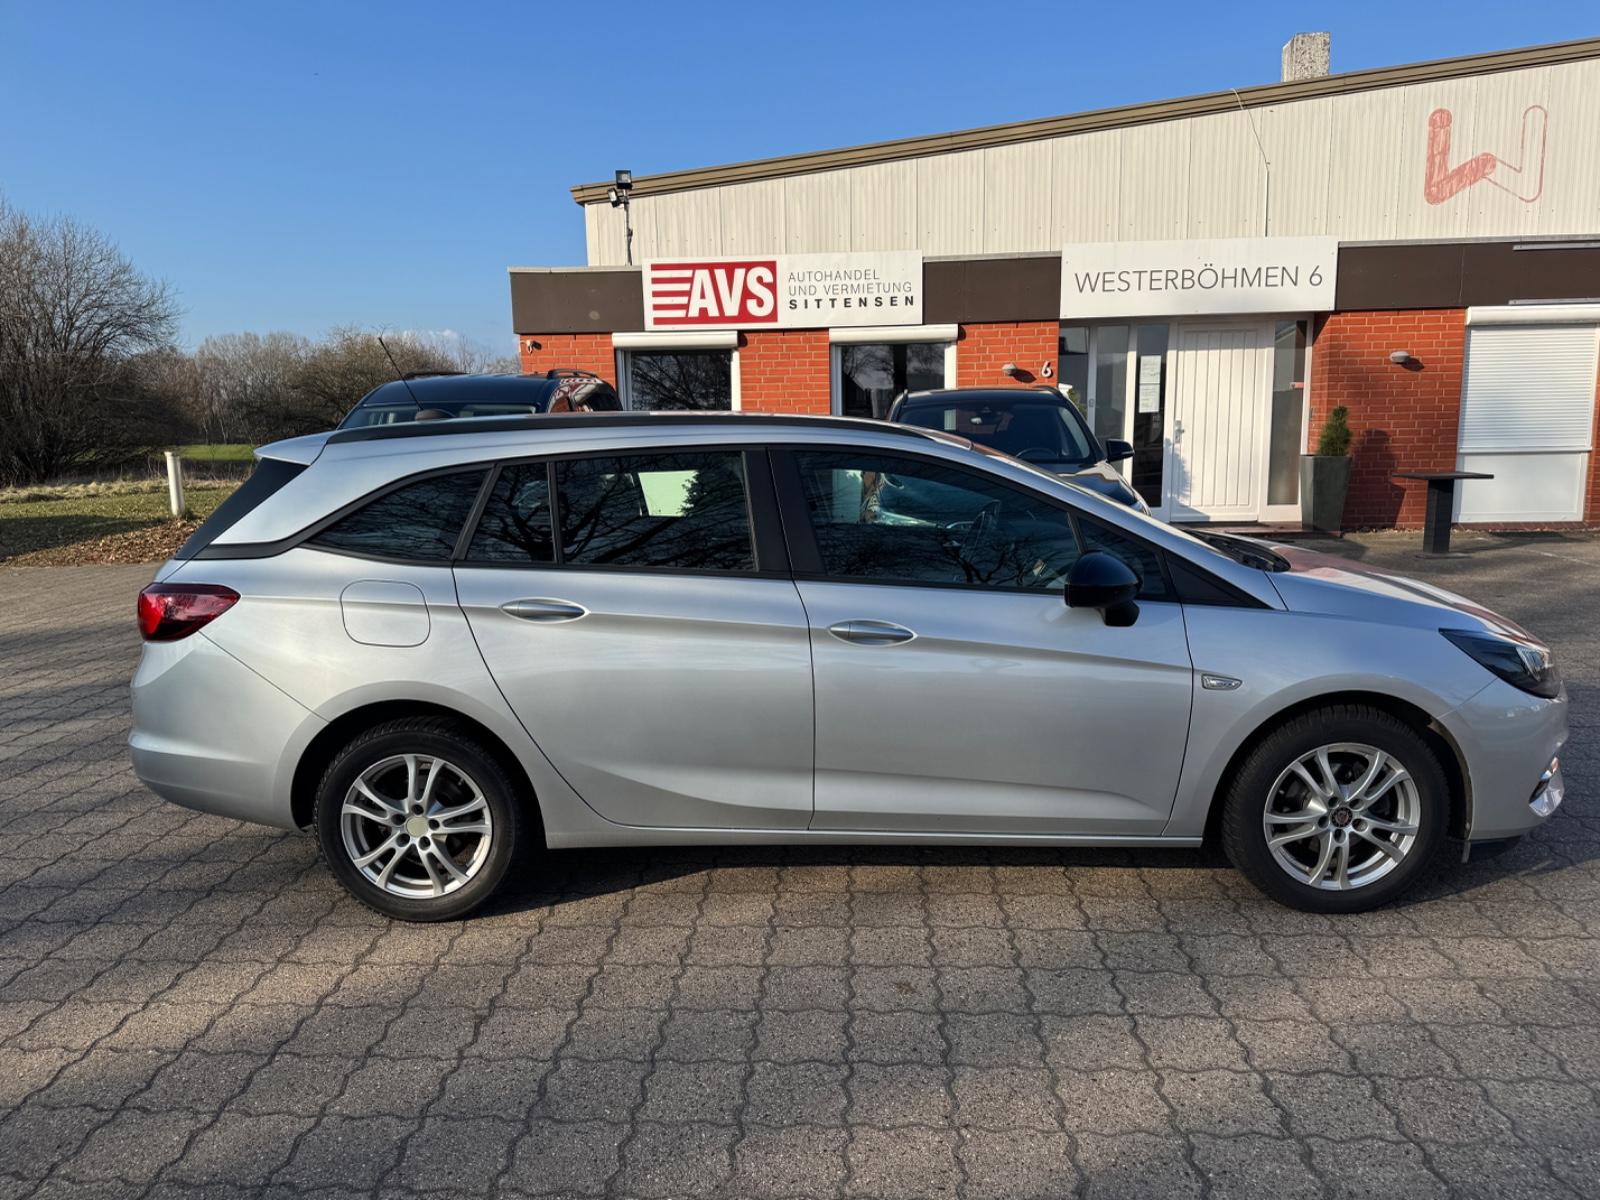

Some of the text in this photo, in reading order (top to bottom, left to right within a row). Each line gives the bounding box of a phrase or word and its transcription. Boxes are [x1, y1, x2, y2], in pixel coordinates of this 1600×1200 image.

[788, 268, 880, 282] AUTOHANDEL
[1074, 263, 1323, 294] WESTERBÖHMEN 6
[687, 265, 775, 318] AVS
[788, 281, 913, 297] UND VERMIETUNG
[788, 295, 915, 310] SITTENSEN
[1041, 360, 1052, 378] 6
